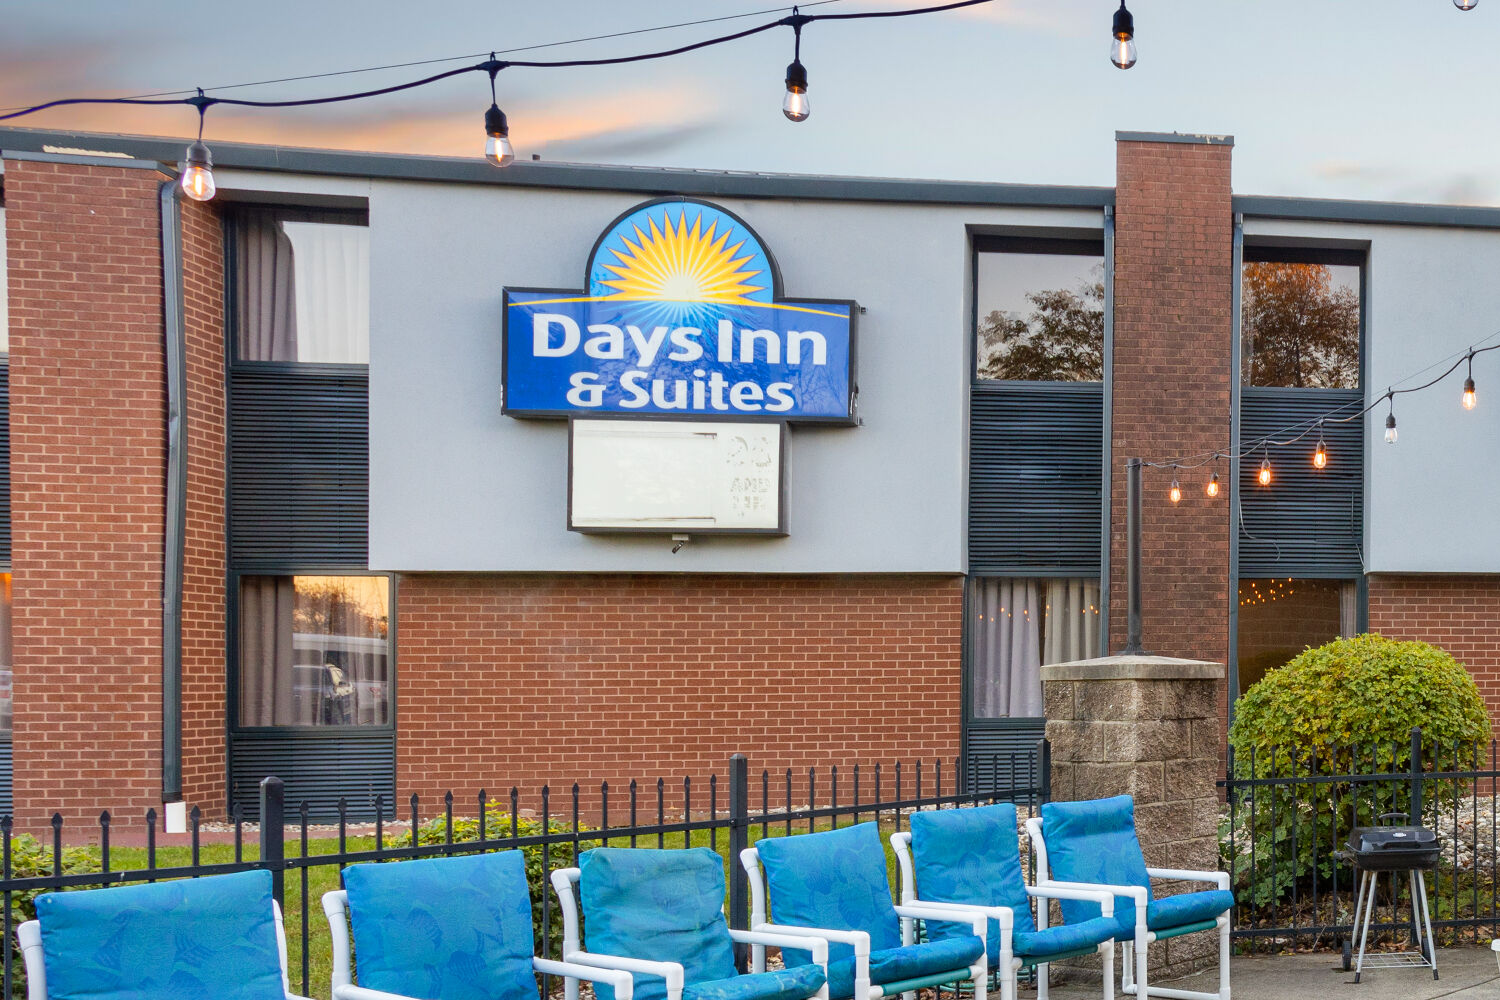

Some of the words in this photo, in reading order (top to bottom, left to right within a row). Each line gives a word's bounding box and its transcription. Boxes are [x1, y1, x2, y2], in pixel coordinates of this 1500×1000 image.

[533, 312, 702, 367] Days
[717, 319, 827, 366] Inn
[566, 371, 607, 407] &
[618, 369, 795, 412] Suites
